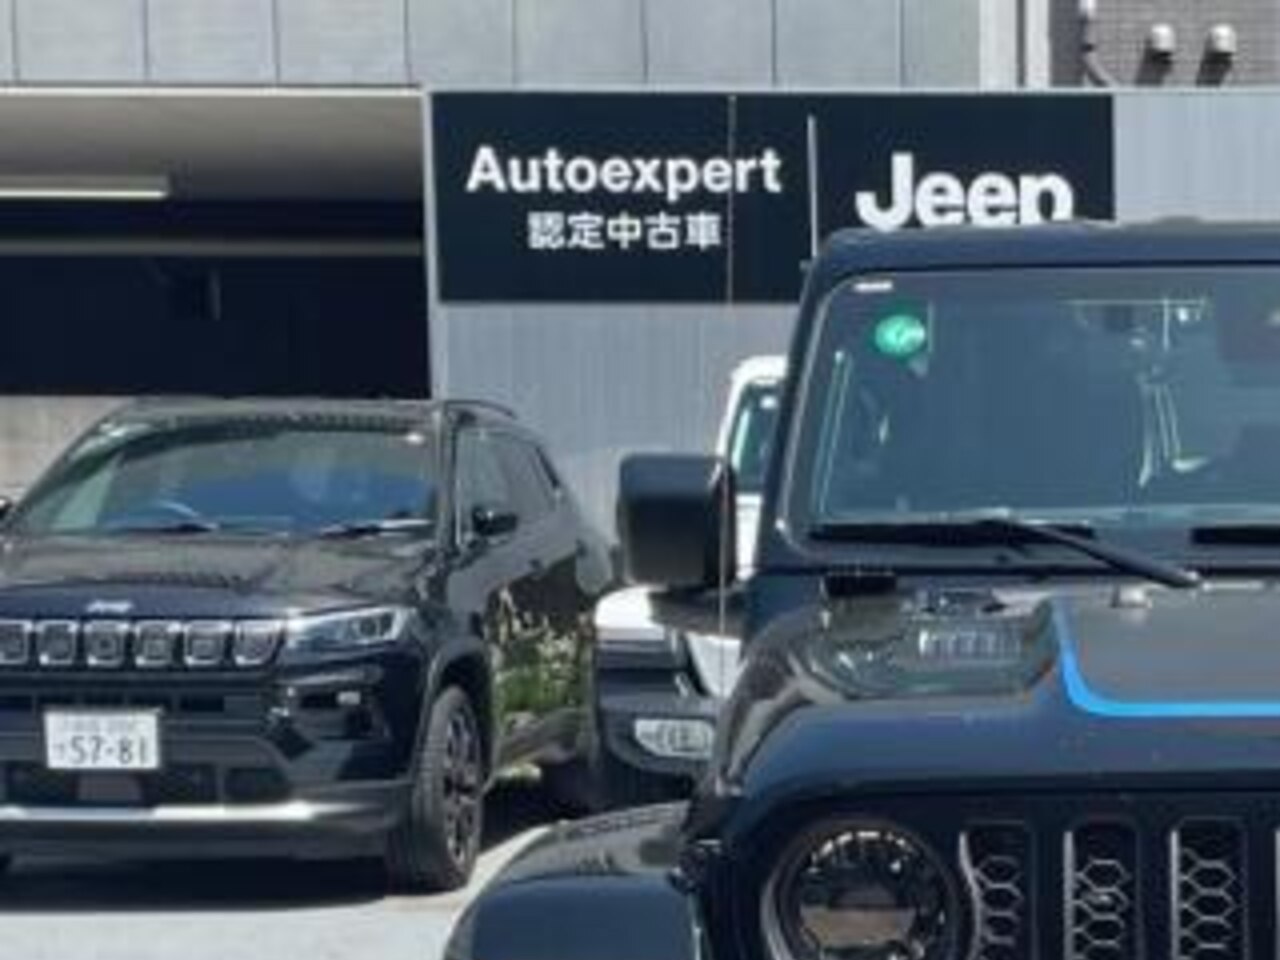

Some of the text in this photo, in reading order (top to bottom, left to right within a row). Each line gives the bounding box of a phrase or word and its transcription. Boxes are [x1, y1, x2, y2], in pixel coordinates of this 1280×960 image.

[466, 145, 783, 201] Autoexpert
[855, 152, 1074, 230] Jeep
[527, 211, 722, 250] 認定中古車
[70, 735, 147, 765] 57-81
